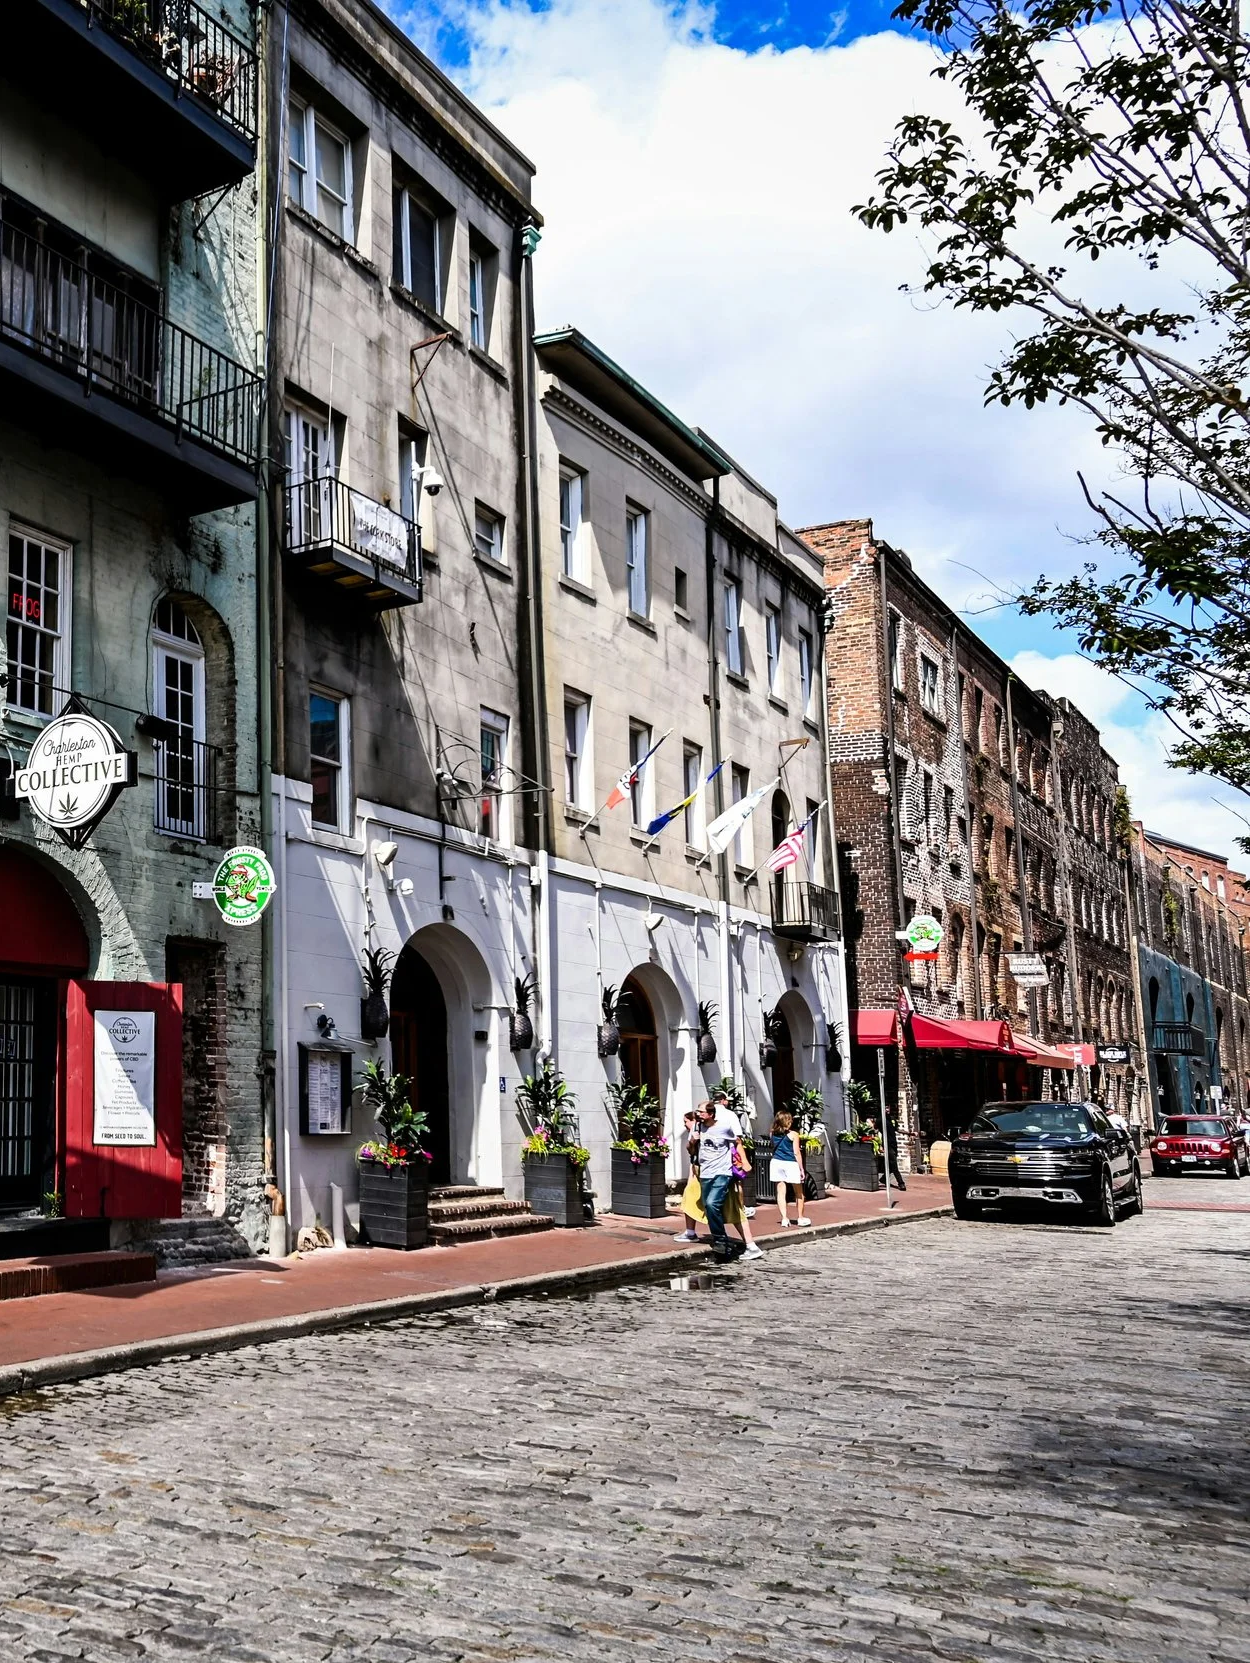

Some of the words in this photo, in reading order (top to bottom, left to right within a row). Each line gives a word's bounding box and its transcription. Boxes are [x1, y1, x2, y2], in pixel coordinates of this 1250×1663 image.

[43, 735, 96, 757] Charleston
[56, 752, 82, 766] HEMP
[17, 758, 123, 793] COLLECTIVE
[217, 866, 229, 882] THE
[228, 856, 255, 869] FROSTY
